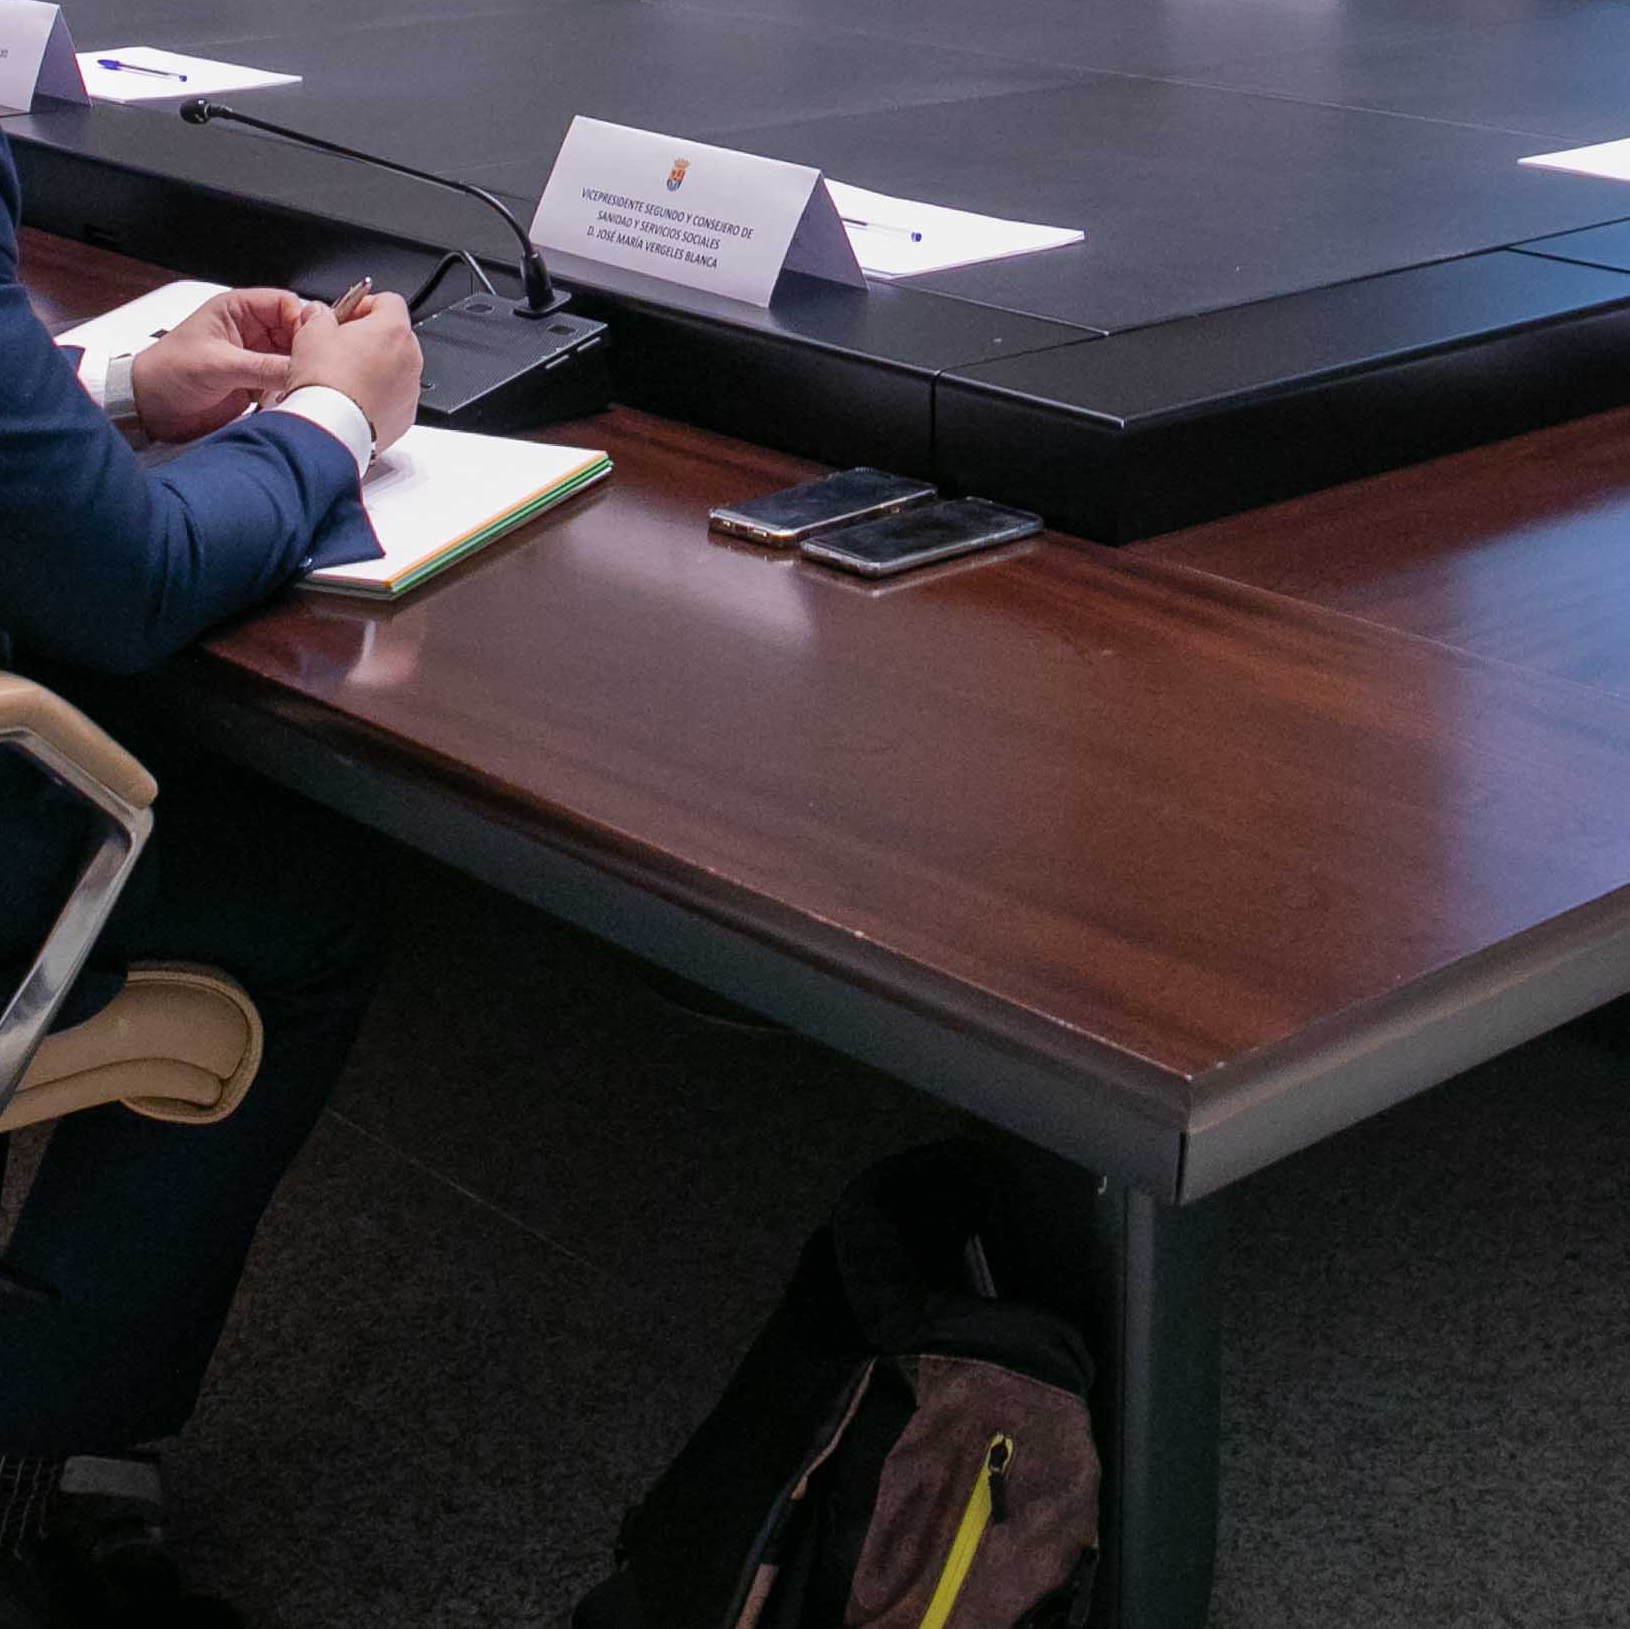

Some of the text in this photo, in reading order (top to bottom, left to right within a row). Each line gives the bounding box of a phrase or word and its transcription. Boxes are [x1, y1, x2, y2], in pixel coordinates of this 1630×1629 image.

[581, 186, 755, 239] VICEPRESIDENTE SEGUNDO Y CONSEJERO DE
[597, 210, 721, 250] SANIDAD Y SERVICIOS SOCIALES
[587, 225, 718, 269] D. JOSÉ MARÍA VERGELES BLANCA
